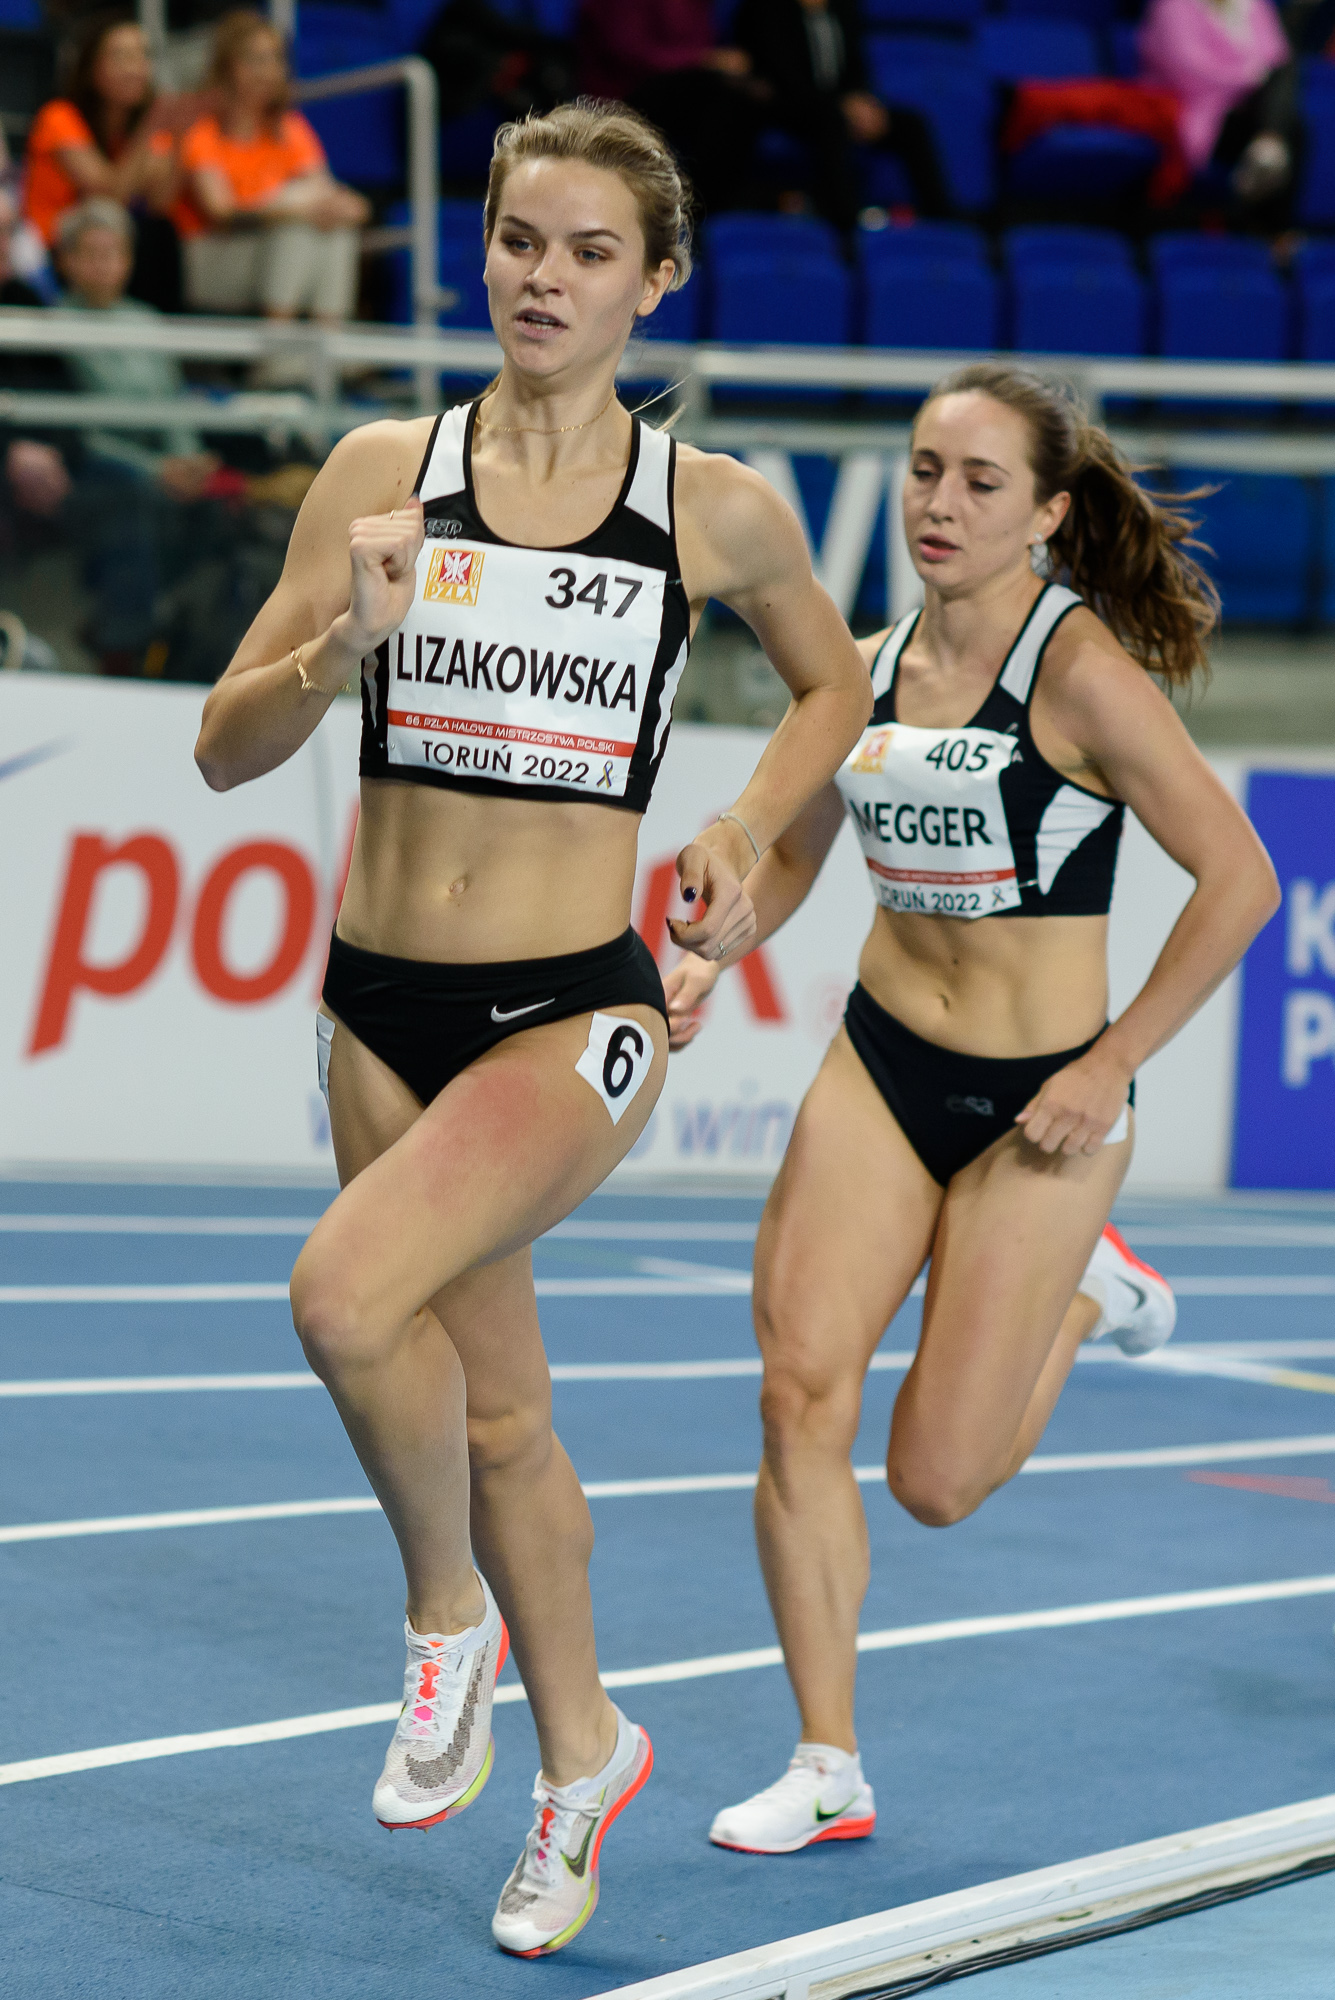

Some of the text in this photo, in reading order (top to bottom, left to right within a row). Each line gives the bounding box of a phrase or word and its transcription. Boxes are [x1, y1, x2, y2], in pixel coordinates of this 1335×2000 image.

[427, 583, 474, 604] PZLA
[545, 567, 643, 618] 347
[396, 632, 637, 713] LIZAKOWSKA
[423, 717, 450, 730] PZLA
[451, 721, 494, 736] HALOWE
[495, 727, 575, 748] MISTRZOSTWA
[577, 739, 615, 753] POLSKI
[925, 738, 995, 772] 405
[422, 740, 590, 784] TORUŃ 2022
[931, 892, 982, 911] 2022
[602, 1025, 644, 1098] 6
